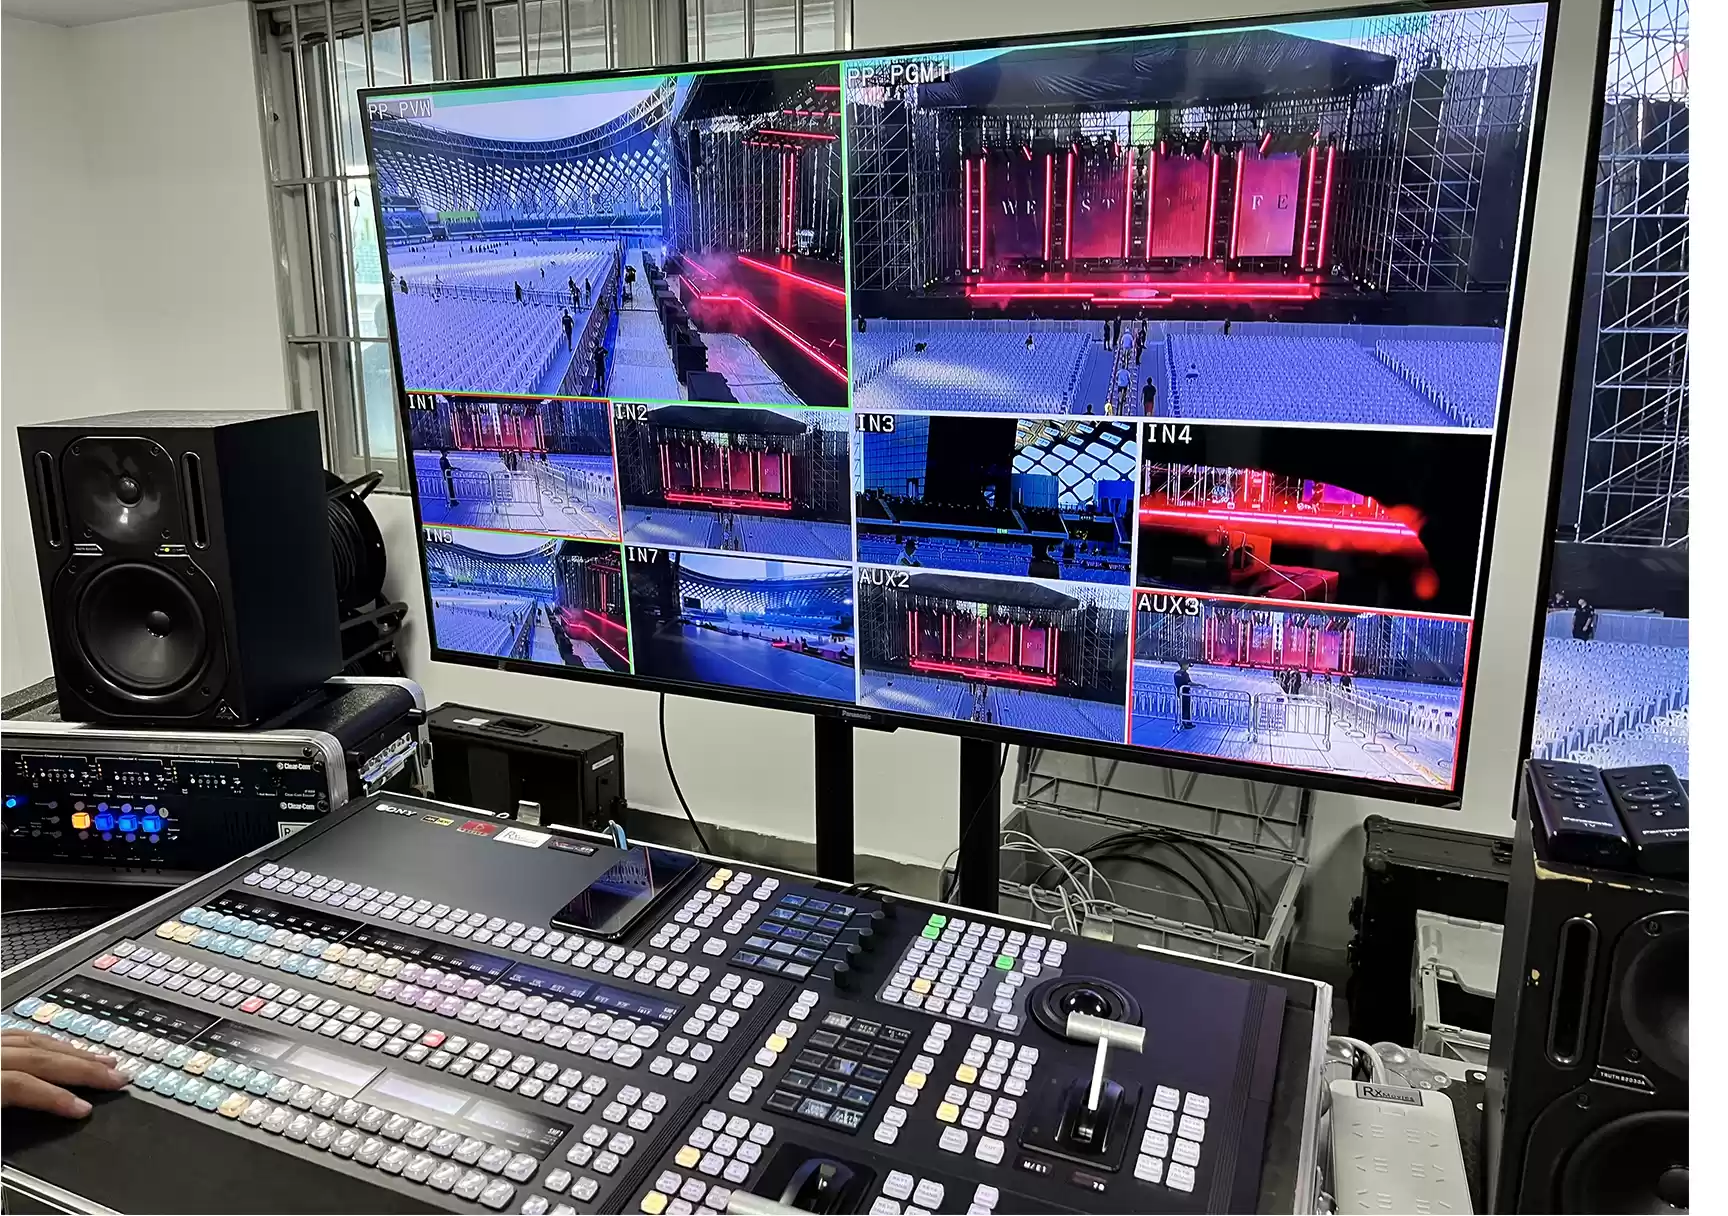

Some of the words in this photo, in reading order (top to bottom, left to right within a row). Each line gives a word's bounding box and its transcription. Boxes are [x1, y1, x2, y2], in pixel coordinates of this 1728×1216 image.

[891, 62, 947, 84] PGM1
[400, 99, 431, 118] PVW
[409, 394, 435, 410] IN1
[615, 404, 648, 421] IN2
[857, 415, 895, 433] IN3
[1148, 424, 1193, 445] IN4
[425, 528, 453, 544] IN5
[628, 547, 658, 564] IN7
[859, 568, 910, 588] AUX2
[1138, 594, 1199, 616] AUX3
[375, 804, 417, 817] SONY
[1600, 1072, 1620, 1081] TRUTH
